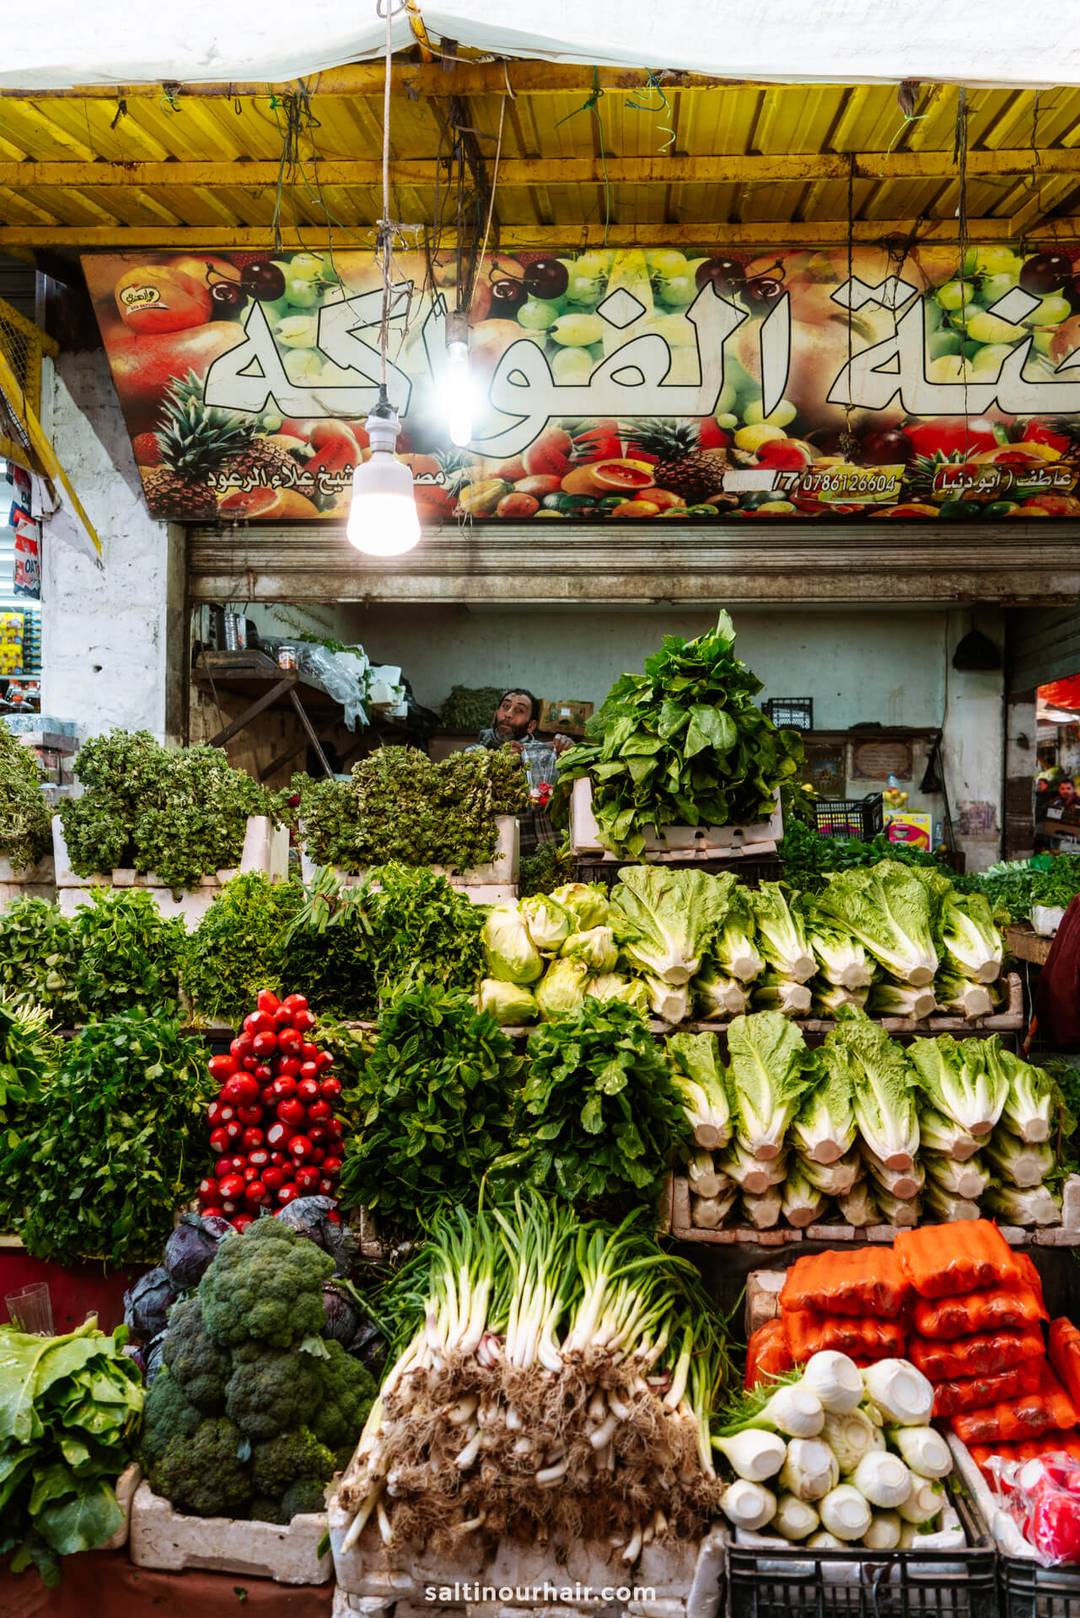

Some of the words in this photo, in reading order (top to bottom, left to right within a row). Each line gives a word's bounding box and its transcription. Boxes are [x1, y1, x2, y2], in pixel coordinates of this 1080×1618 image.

[207, 465, 267, 493] الرعود
[271, 465, 314, 489] علاء
[802, 474, 896, 492] 0786126604
[1016, 468, 1072, 487] عاطف
